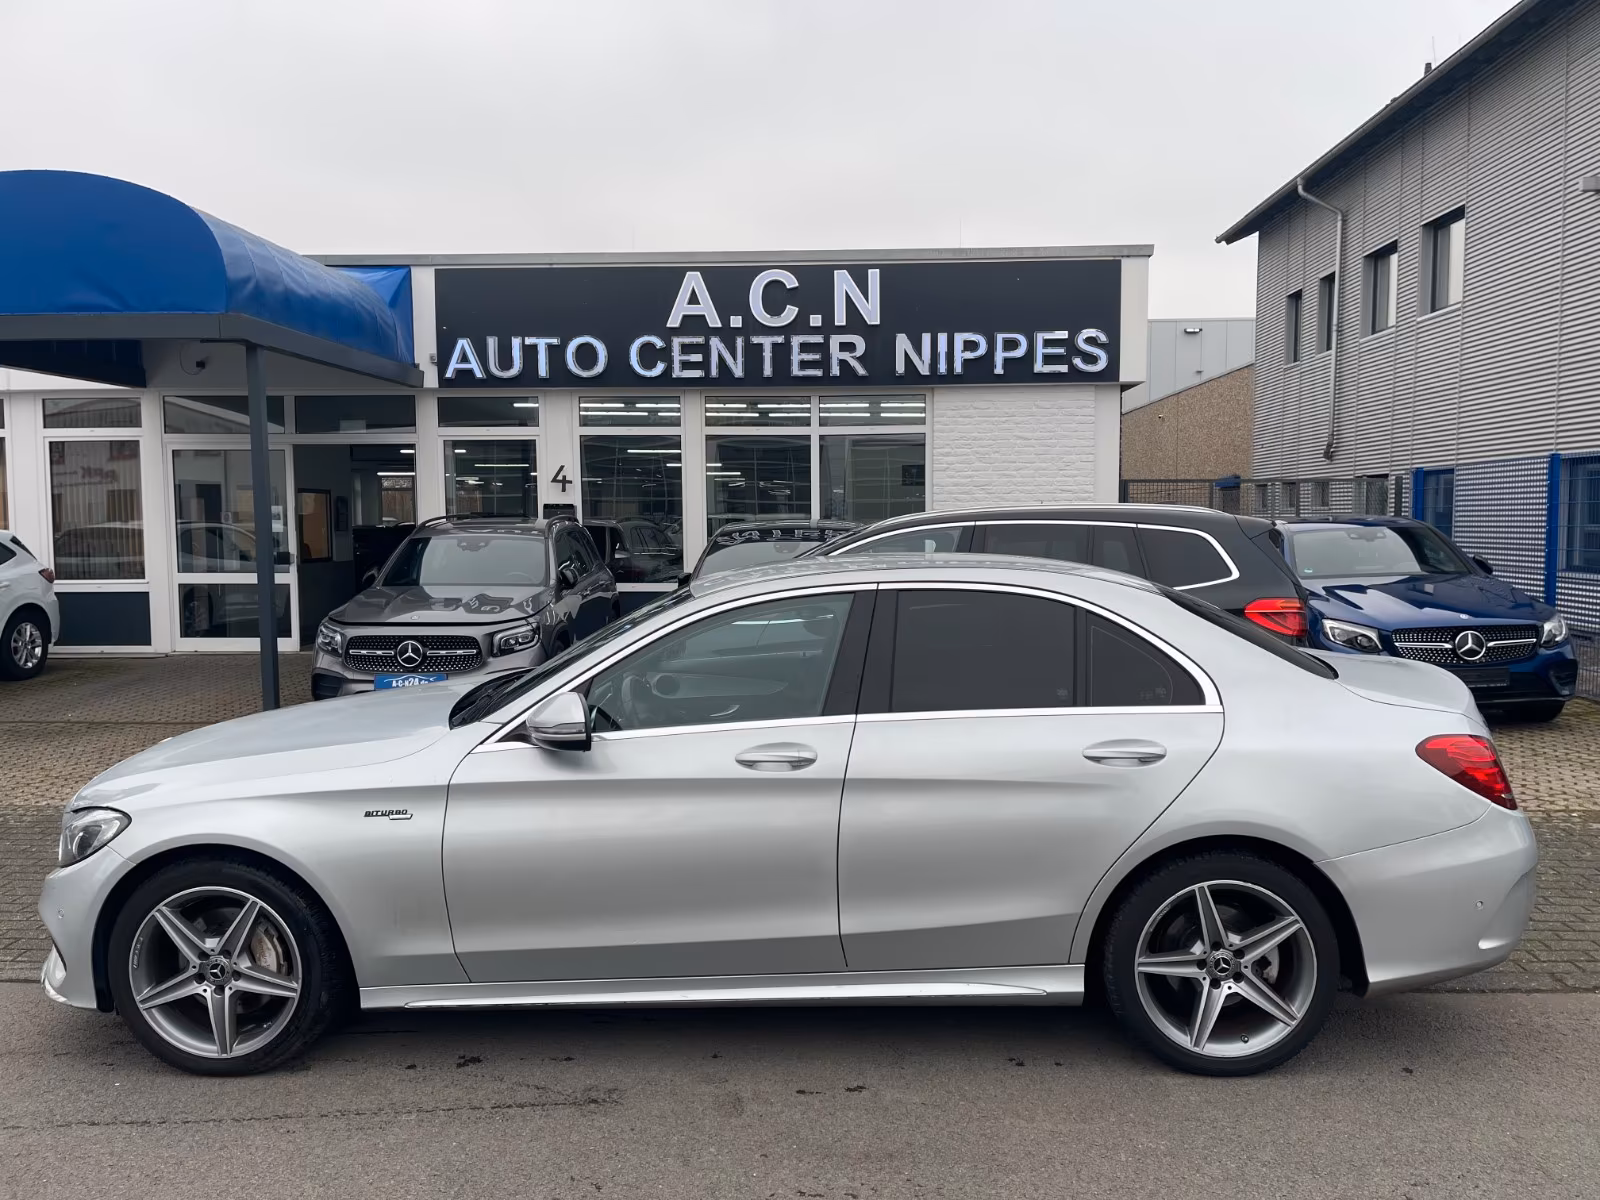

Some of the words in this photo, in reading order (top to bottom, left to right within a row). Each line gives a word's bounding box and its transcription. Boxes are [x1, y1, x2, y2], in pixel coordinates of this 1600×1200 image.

[666, 269, 880, 328] A.C.N
[444, 335, 608, 379] AUTO
[629, 333, 869, 379] CENTER
[895, 328, 1109, 376] NIPPES
[550, 464, 573, 493] 4
[363, 809, 408, 817] BITURBO
